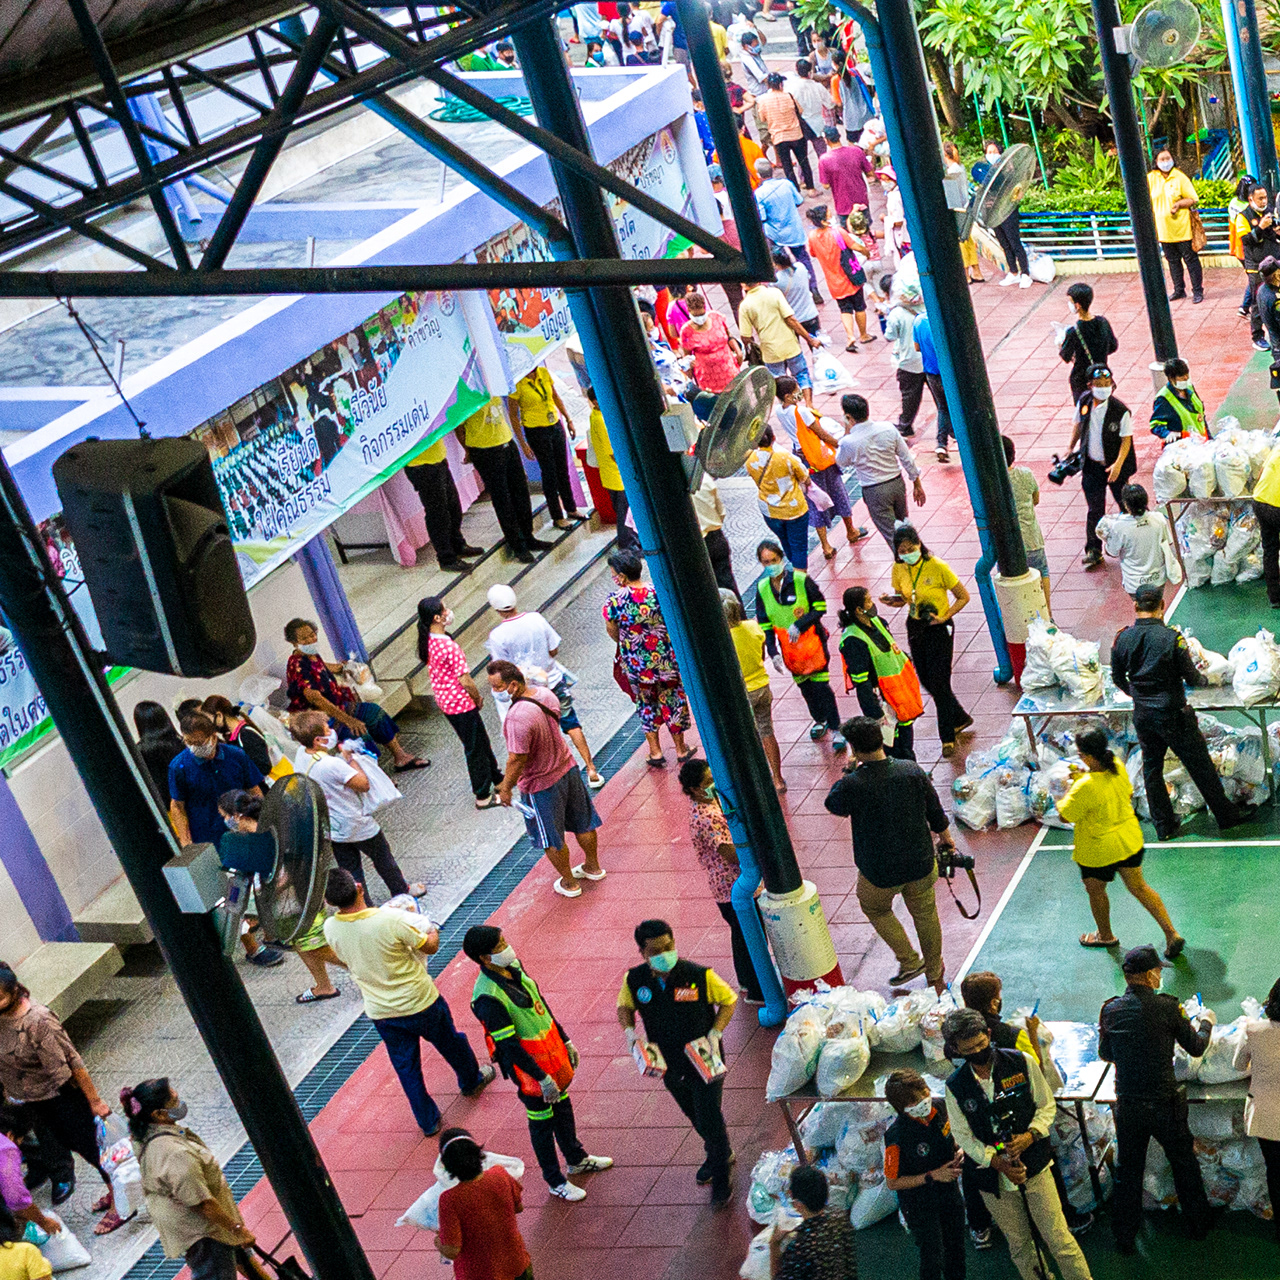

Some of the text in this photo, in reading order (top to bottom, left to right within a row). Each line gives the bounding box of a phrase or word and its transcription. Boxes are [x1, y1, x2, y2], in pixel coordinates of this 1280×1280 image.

[407, 315, 442, 349] คำขวัญ
[255, 398, 430, 541] ใฝ่คุณธรรม กิจกรรมเด่น
[277, 378, 388, 481] เรียนดี มีวินัย
